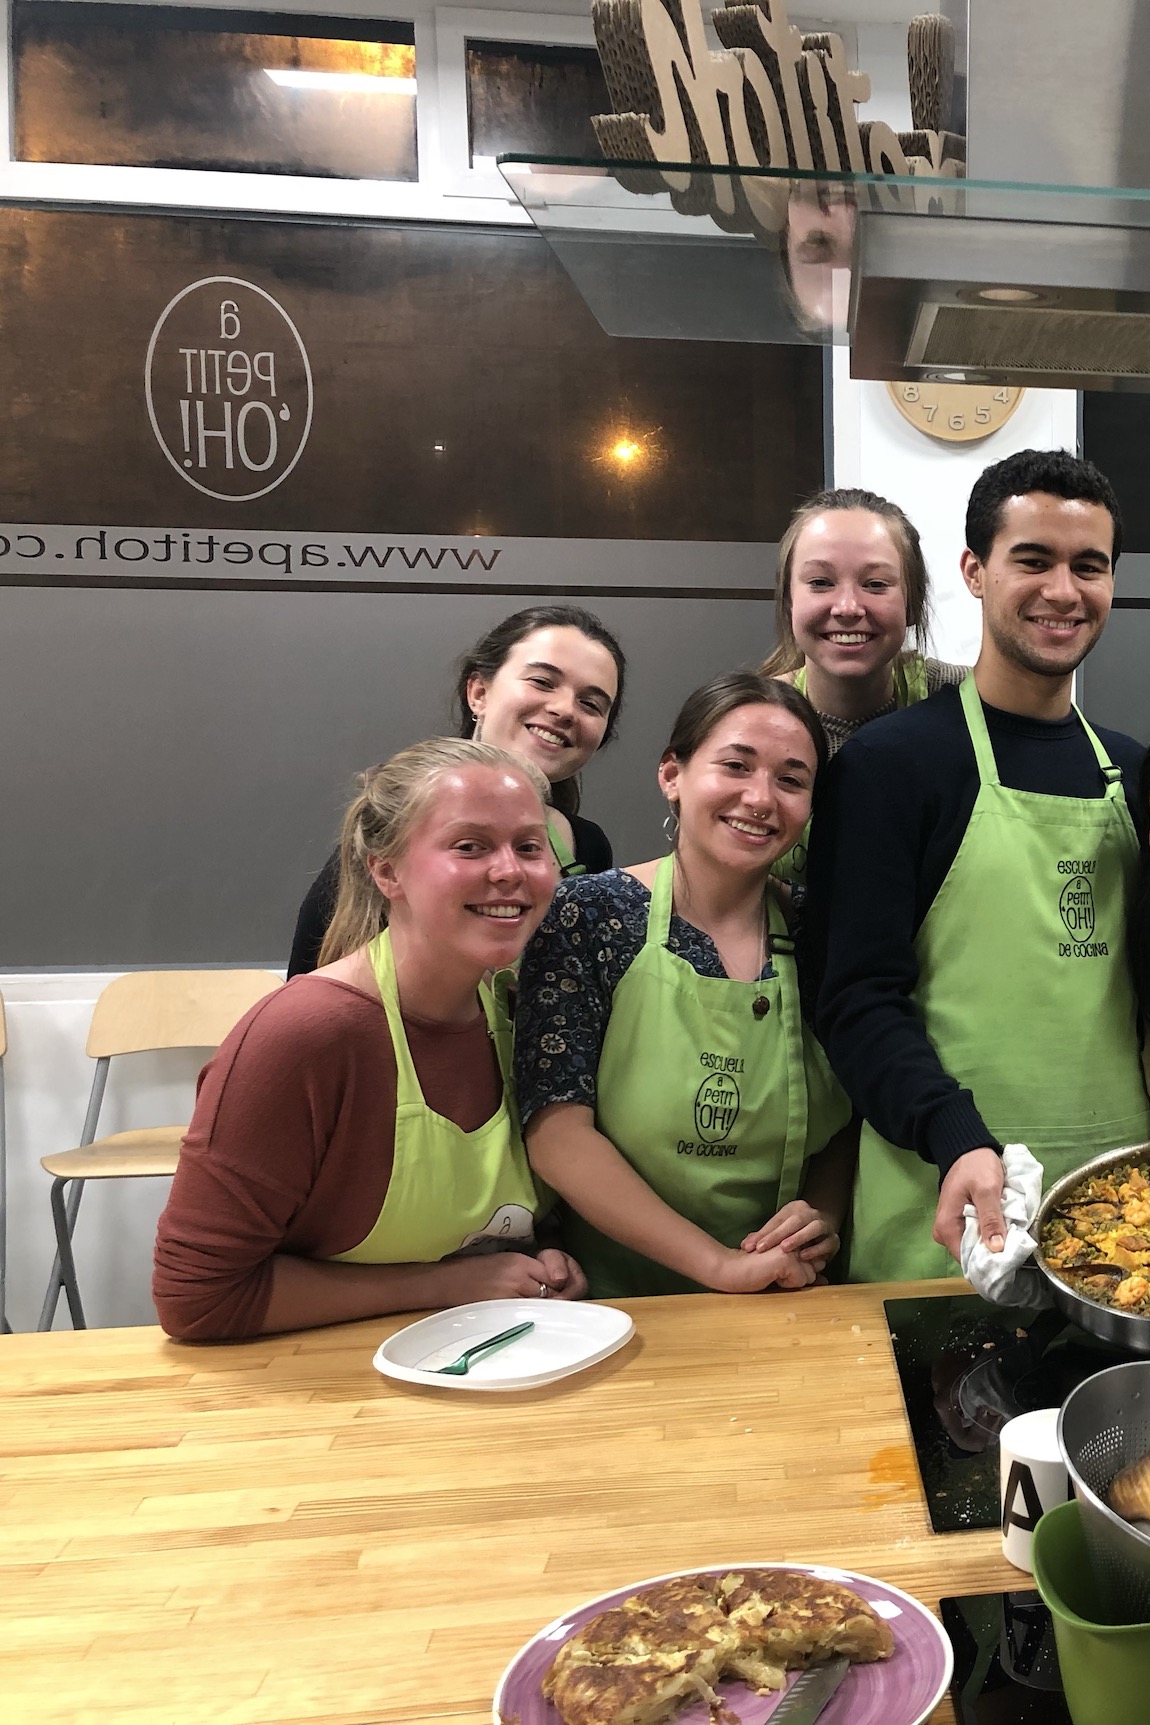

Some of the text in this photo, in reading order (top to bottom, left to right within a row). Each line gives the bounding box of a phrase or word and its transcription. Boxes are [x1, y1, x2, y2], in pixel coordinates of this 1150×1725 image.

[903, 384, 920, 402] 8
[993, 387, 1009, 404] 4
[922, 404, 938, 422] 7
[948, 413, 965, 431] 6
[975, 404, 991, 424] 5
[1003, 1459, 1044, 1538] A
